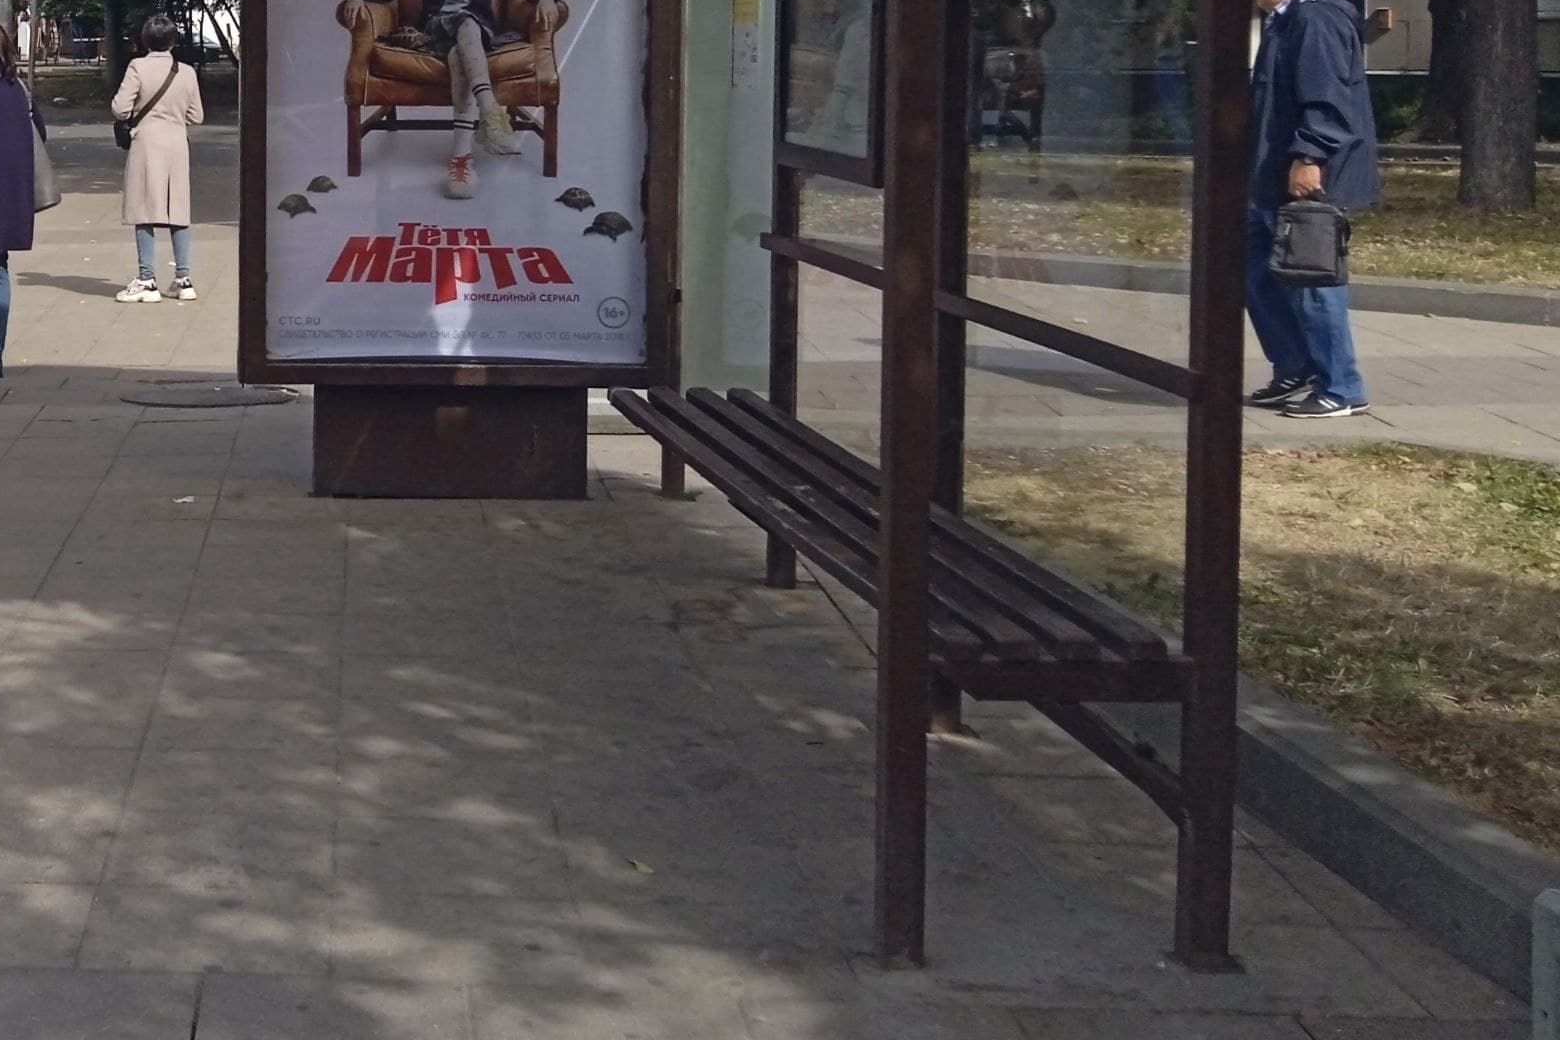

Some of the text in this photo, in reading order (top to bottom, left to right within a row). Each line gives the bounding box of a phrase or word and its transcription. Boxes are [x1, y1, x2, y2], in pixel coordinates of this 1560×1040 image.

[398, 222, 492, 246] Тётя
[326, 236, 574, 305] Марта
[464, 292, 580, 303] КОМЕДИЙНЫЙ СЕРИАЛ
[603, 306, 626, 319] 16+
